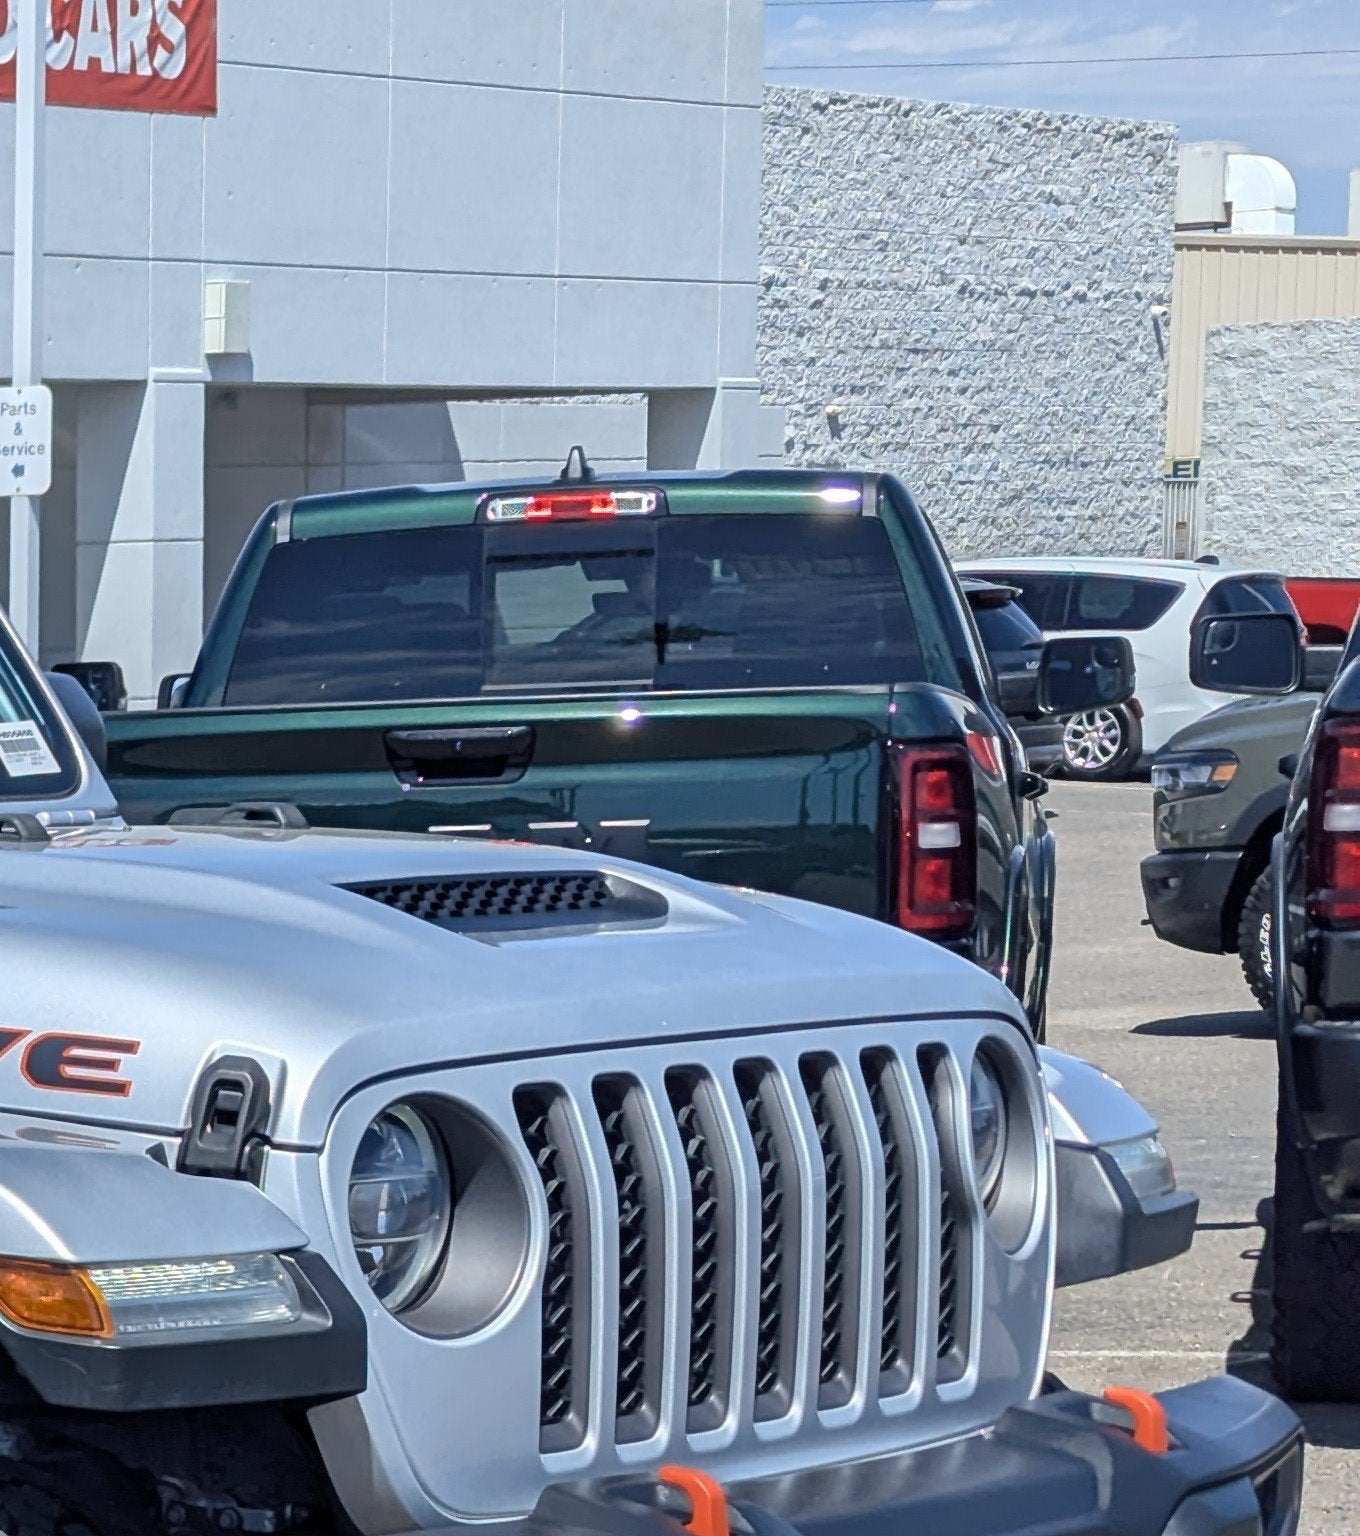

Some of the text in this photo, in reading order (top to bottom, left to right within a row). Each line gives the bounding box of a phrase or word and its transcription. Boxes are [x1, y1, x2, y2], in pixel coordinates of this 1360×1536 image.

[45, 0, 187, 80] CARS
[0, 402, 37, 416] Parts
[13, 422, 23, 436] &
